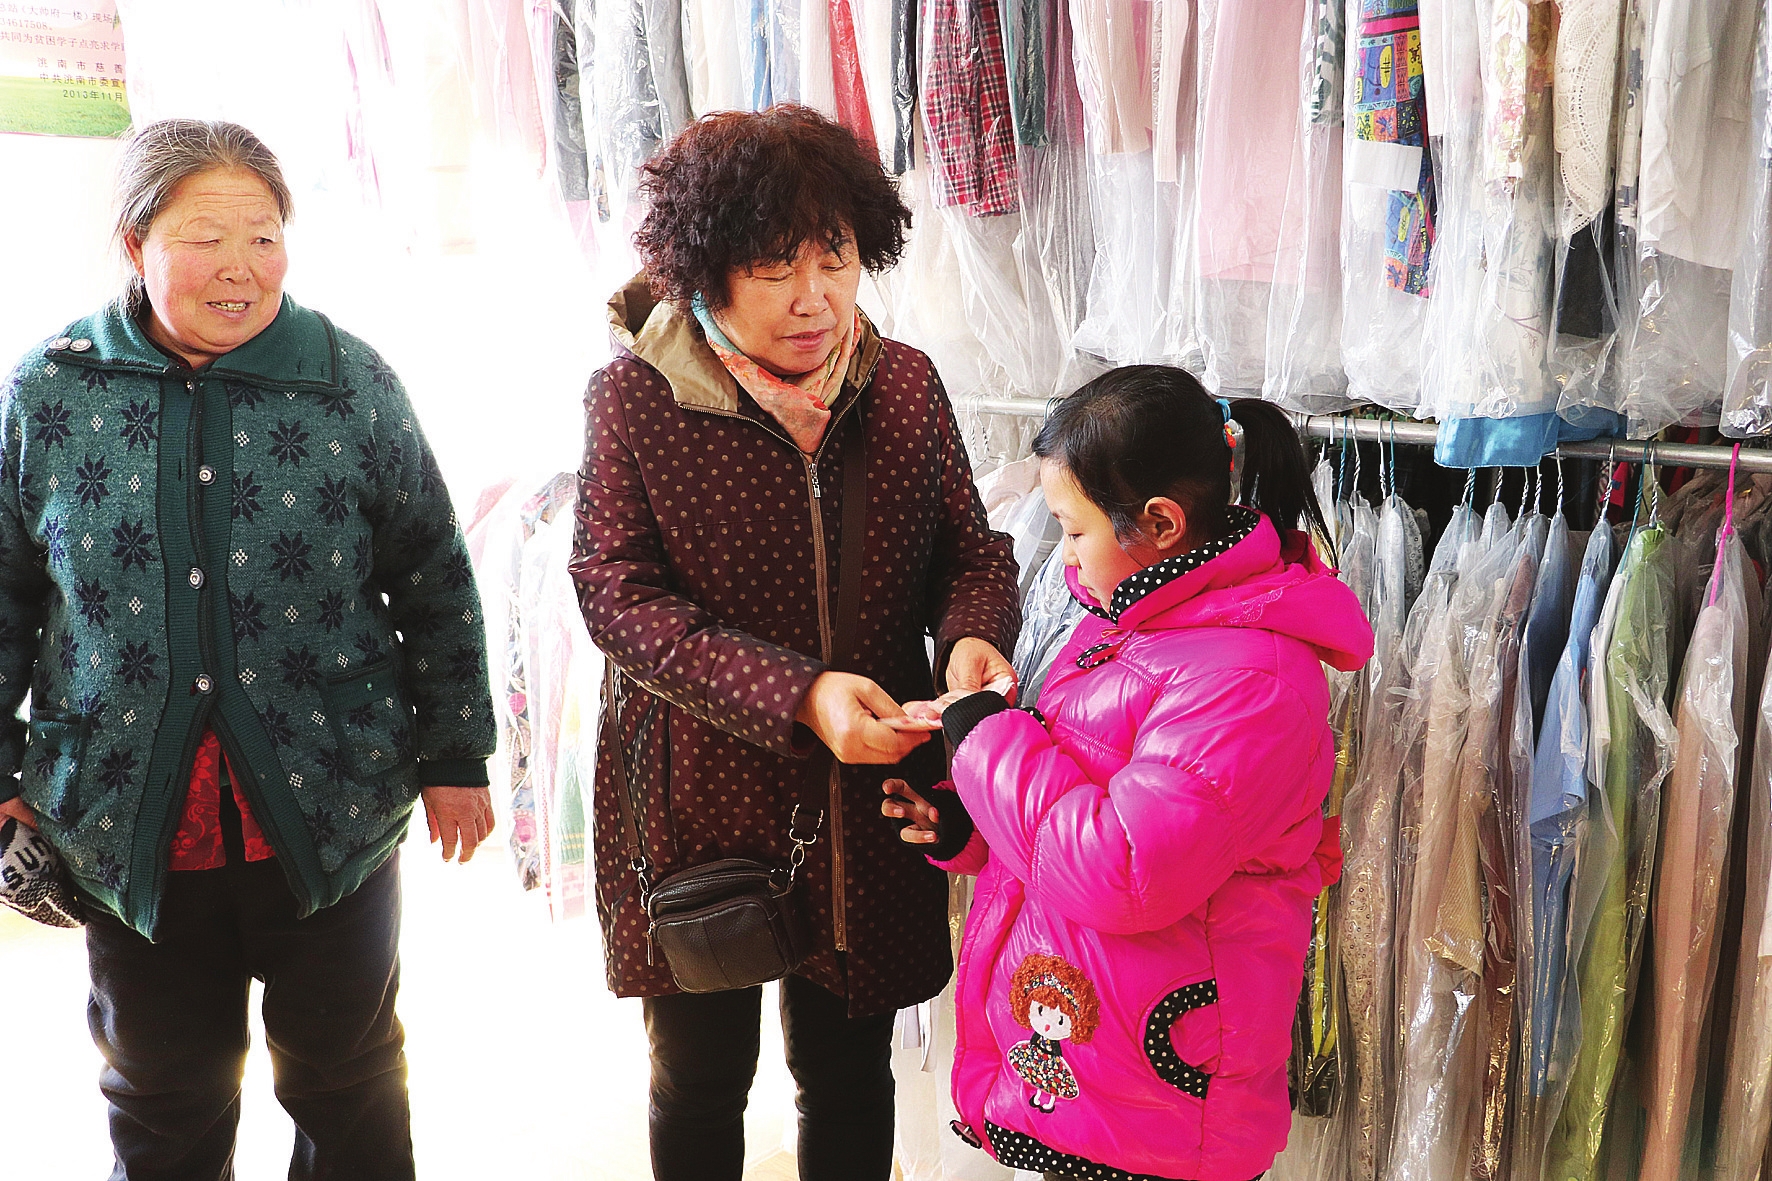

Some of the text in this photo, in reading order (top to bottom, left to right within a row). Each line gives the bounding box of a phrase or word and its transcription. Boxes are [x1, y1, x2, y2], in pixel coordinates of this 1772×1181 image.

[0, 31, 125, 52] 共同为贫困学子点亮求学
